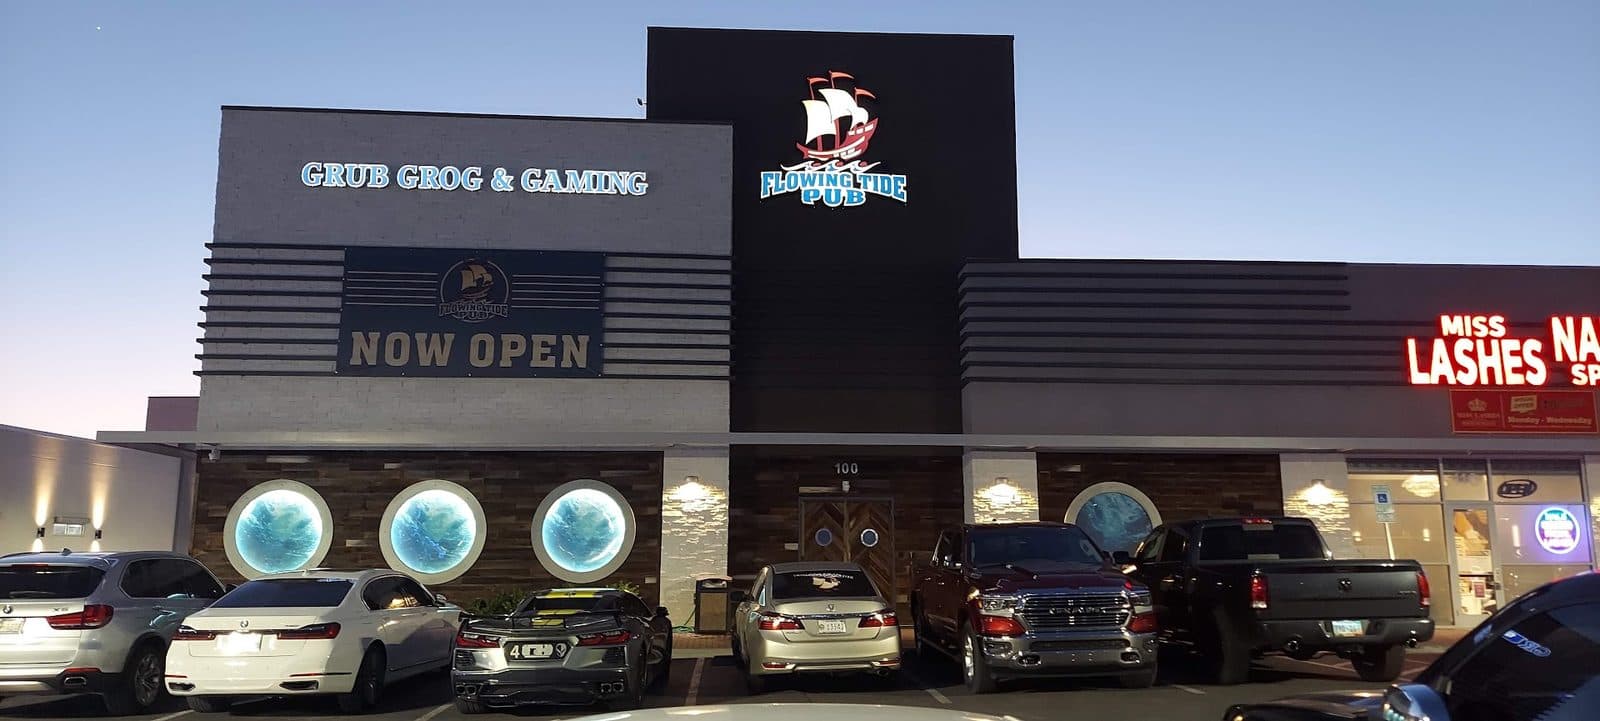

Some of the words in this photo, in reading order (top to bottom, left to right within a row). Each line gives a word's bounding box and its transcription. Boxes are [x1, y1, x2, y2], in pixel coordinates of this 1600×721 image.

[302, 162, 390, 188] GRUB
[396, 164, 482, 191] GROG
[490, 167, 513, 191] &
[520, 168, 648, 195] GAMING
[761, 172, 853, 199] FLOWING
[857, 174, 907, 202] TIDE
[801, 188, 866, 206] PUB
[1440, 315, 1506, 337] MISS
[1551, 316, 1600, 362] NA
[351, 332, 454, 367] NOW
[469, 333, 590, 368] OPEN
[1406, 338, 1547, 386] LASHES
[1570, 363, 1600, 386] SP
[1508, 416, 1539, 425] Monday
[1546, 416, 1592, 425] Wednesday
[834, 463, 858, 474] 100
